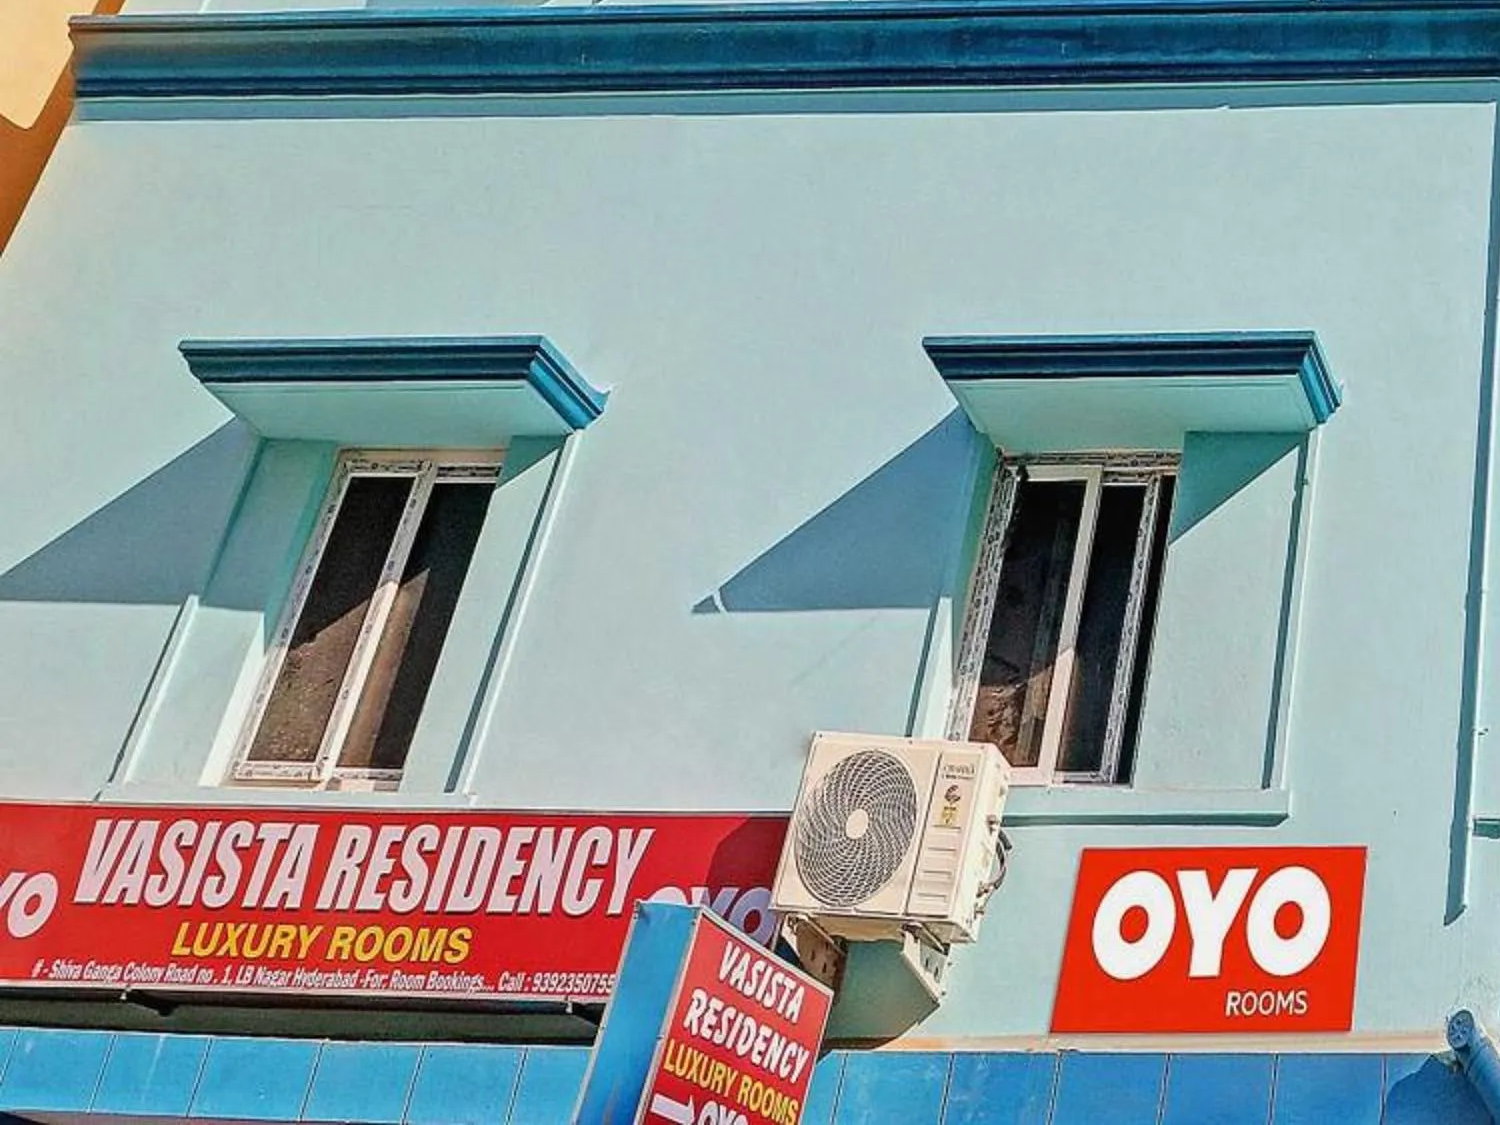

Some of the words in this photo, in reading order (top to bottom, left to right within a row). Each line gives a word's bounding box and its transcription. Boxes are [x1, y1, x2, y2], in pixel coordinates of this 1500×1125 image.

[73, 818, 321, 909] VASISTA
[314, 823, 656, 916] RESIDENCY
[171, 922, 324, 959] LUXURY
[326, 925, 472, 963] ROOMS
[1092, 865, 1332, 981] OYO
[49, 958, 82, 979] Shiva
[83, 960, 123, 982] Ganga
[123, 961, 165, 983] Colony
[163, 963, 198, 983] Road
[235, 965, 255, 984] LB
[253, 966, 293, 986] Nagar
[292, 967, 360, 989] Hyderabad
[389, 970, 426, 990] Room
[719, 941, 806, 1023] VASISTA
[1225, 990, 1308, 1016] ROOMS
[683, 989, 810, 1084] RESIDENCY
[663, 1039, 738, 1098] LUXURY
[737, 1076, 799, 1125] ROOMS
